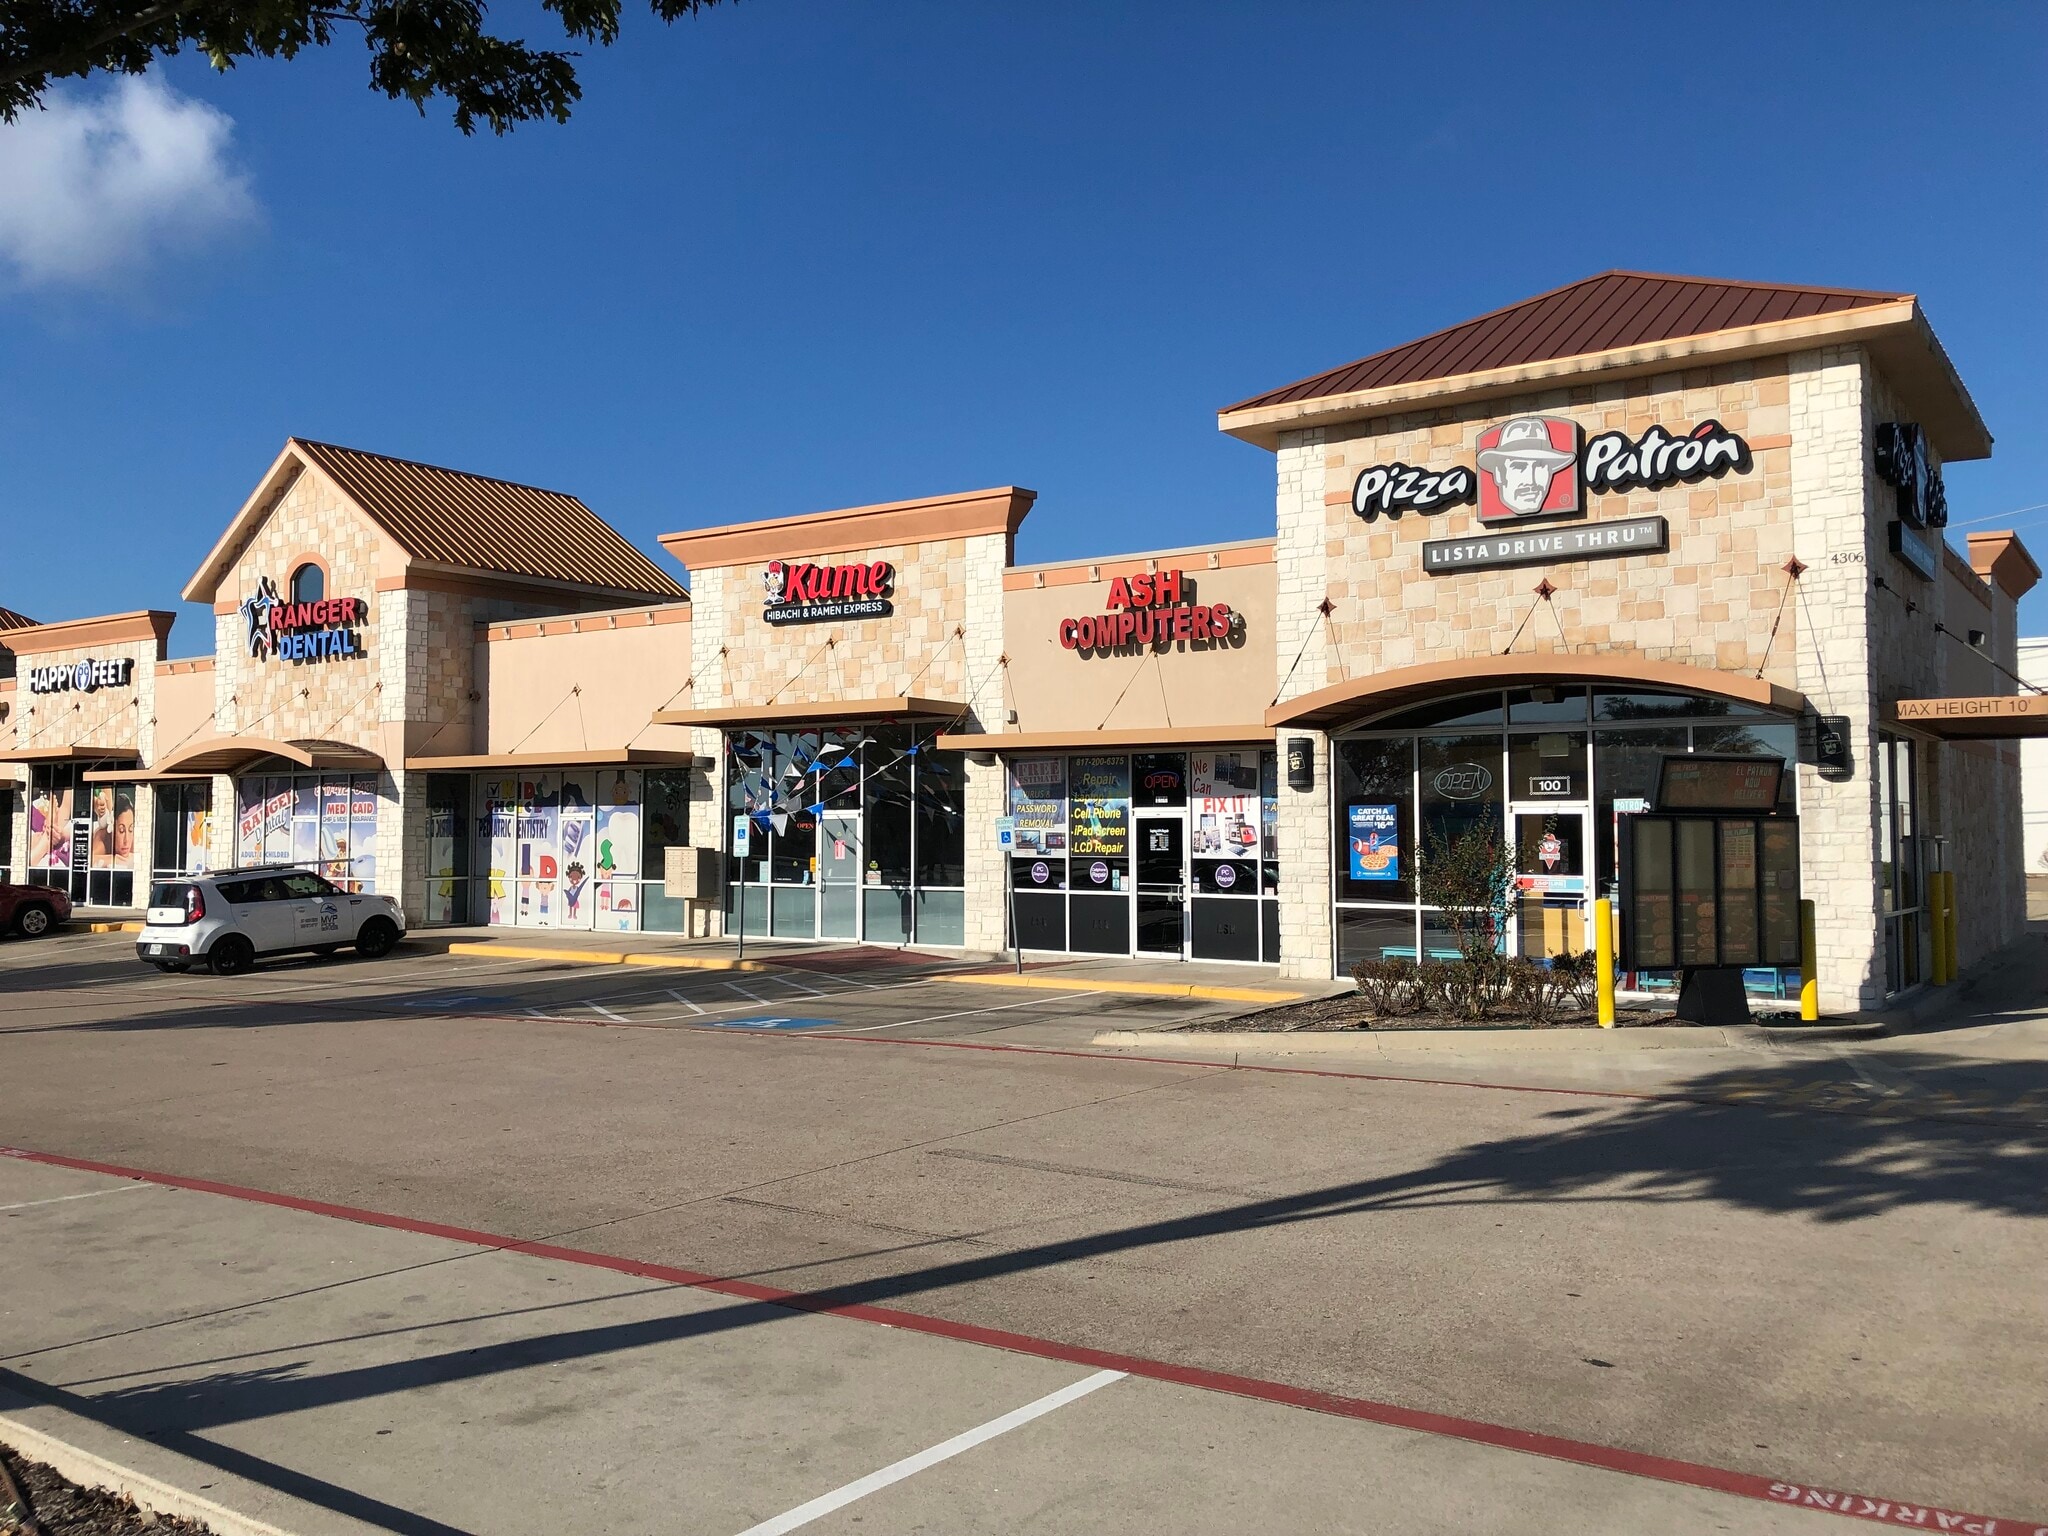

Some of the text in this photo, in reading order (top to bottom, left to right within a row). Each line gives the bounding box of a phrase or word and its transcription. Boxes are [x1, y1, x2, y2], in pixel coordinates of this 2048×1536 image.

[1356, 424, 1739, 512] Pizza Patrón
[1432, 544, 1489, 563] LISTA
[1498, 536, 1563, 556] DRIVE
[1831, 552, 1864, 564] 4306
[785, 561, 887, 602] Kume
[1106, 569, 1182, 610] ASH
[270, 597, 356, 630] RANGER
[766, 601, 883, 620] HIBACHI & RAMEN EXPRESS
[1059, 603, 1230, 650] COMPUTERS
[280, 629, 354, 661] DENTAL
[29, 659, 125, 691] HAPPY FEET
[1896, 703, 1930, 717] MAX
[1936, 700, 2002, 716] HEIGHT
[1018, 761, 1060, 776] FREE
[1075, 757, 1125, 767] 817-200-6375
[1192, 758, 1208, 775] We
[1437, 767, 1487, 790] OPEN
[1735, 765, 1745, 776] EL
[1018, 774, 1060, 785] ESTIMATE
[1082, 772, 1116, 787] Repair
[1144, 775, 1177, 789] OPEN
[1193, 777, 1212, 795] Can
[1538, 780, 1561, 791] 100
[327, 803, 374, 815] MEDCAID
[485, 799, 543, 814] CHOICE
[1016, 804, 1058, 813] PASSWORD
[1203, 796, 1228, 813] FIX
[1074, 807, 1122, 819] Cell Phone
[513, 818, 548, 838] ENTISTRY
[1019, 819, 1055, 829] REMOVAL
[1074, 824, 1126, 836] iPad Screen
[1074, 841, 1124, 856] LCD Repair
[1217, 875, 1234, 883] Repair
[1767, 1482, 1997, 1536] PARKING
